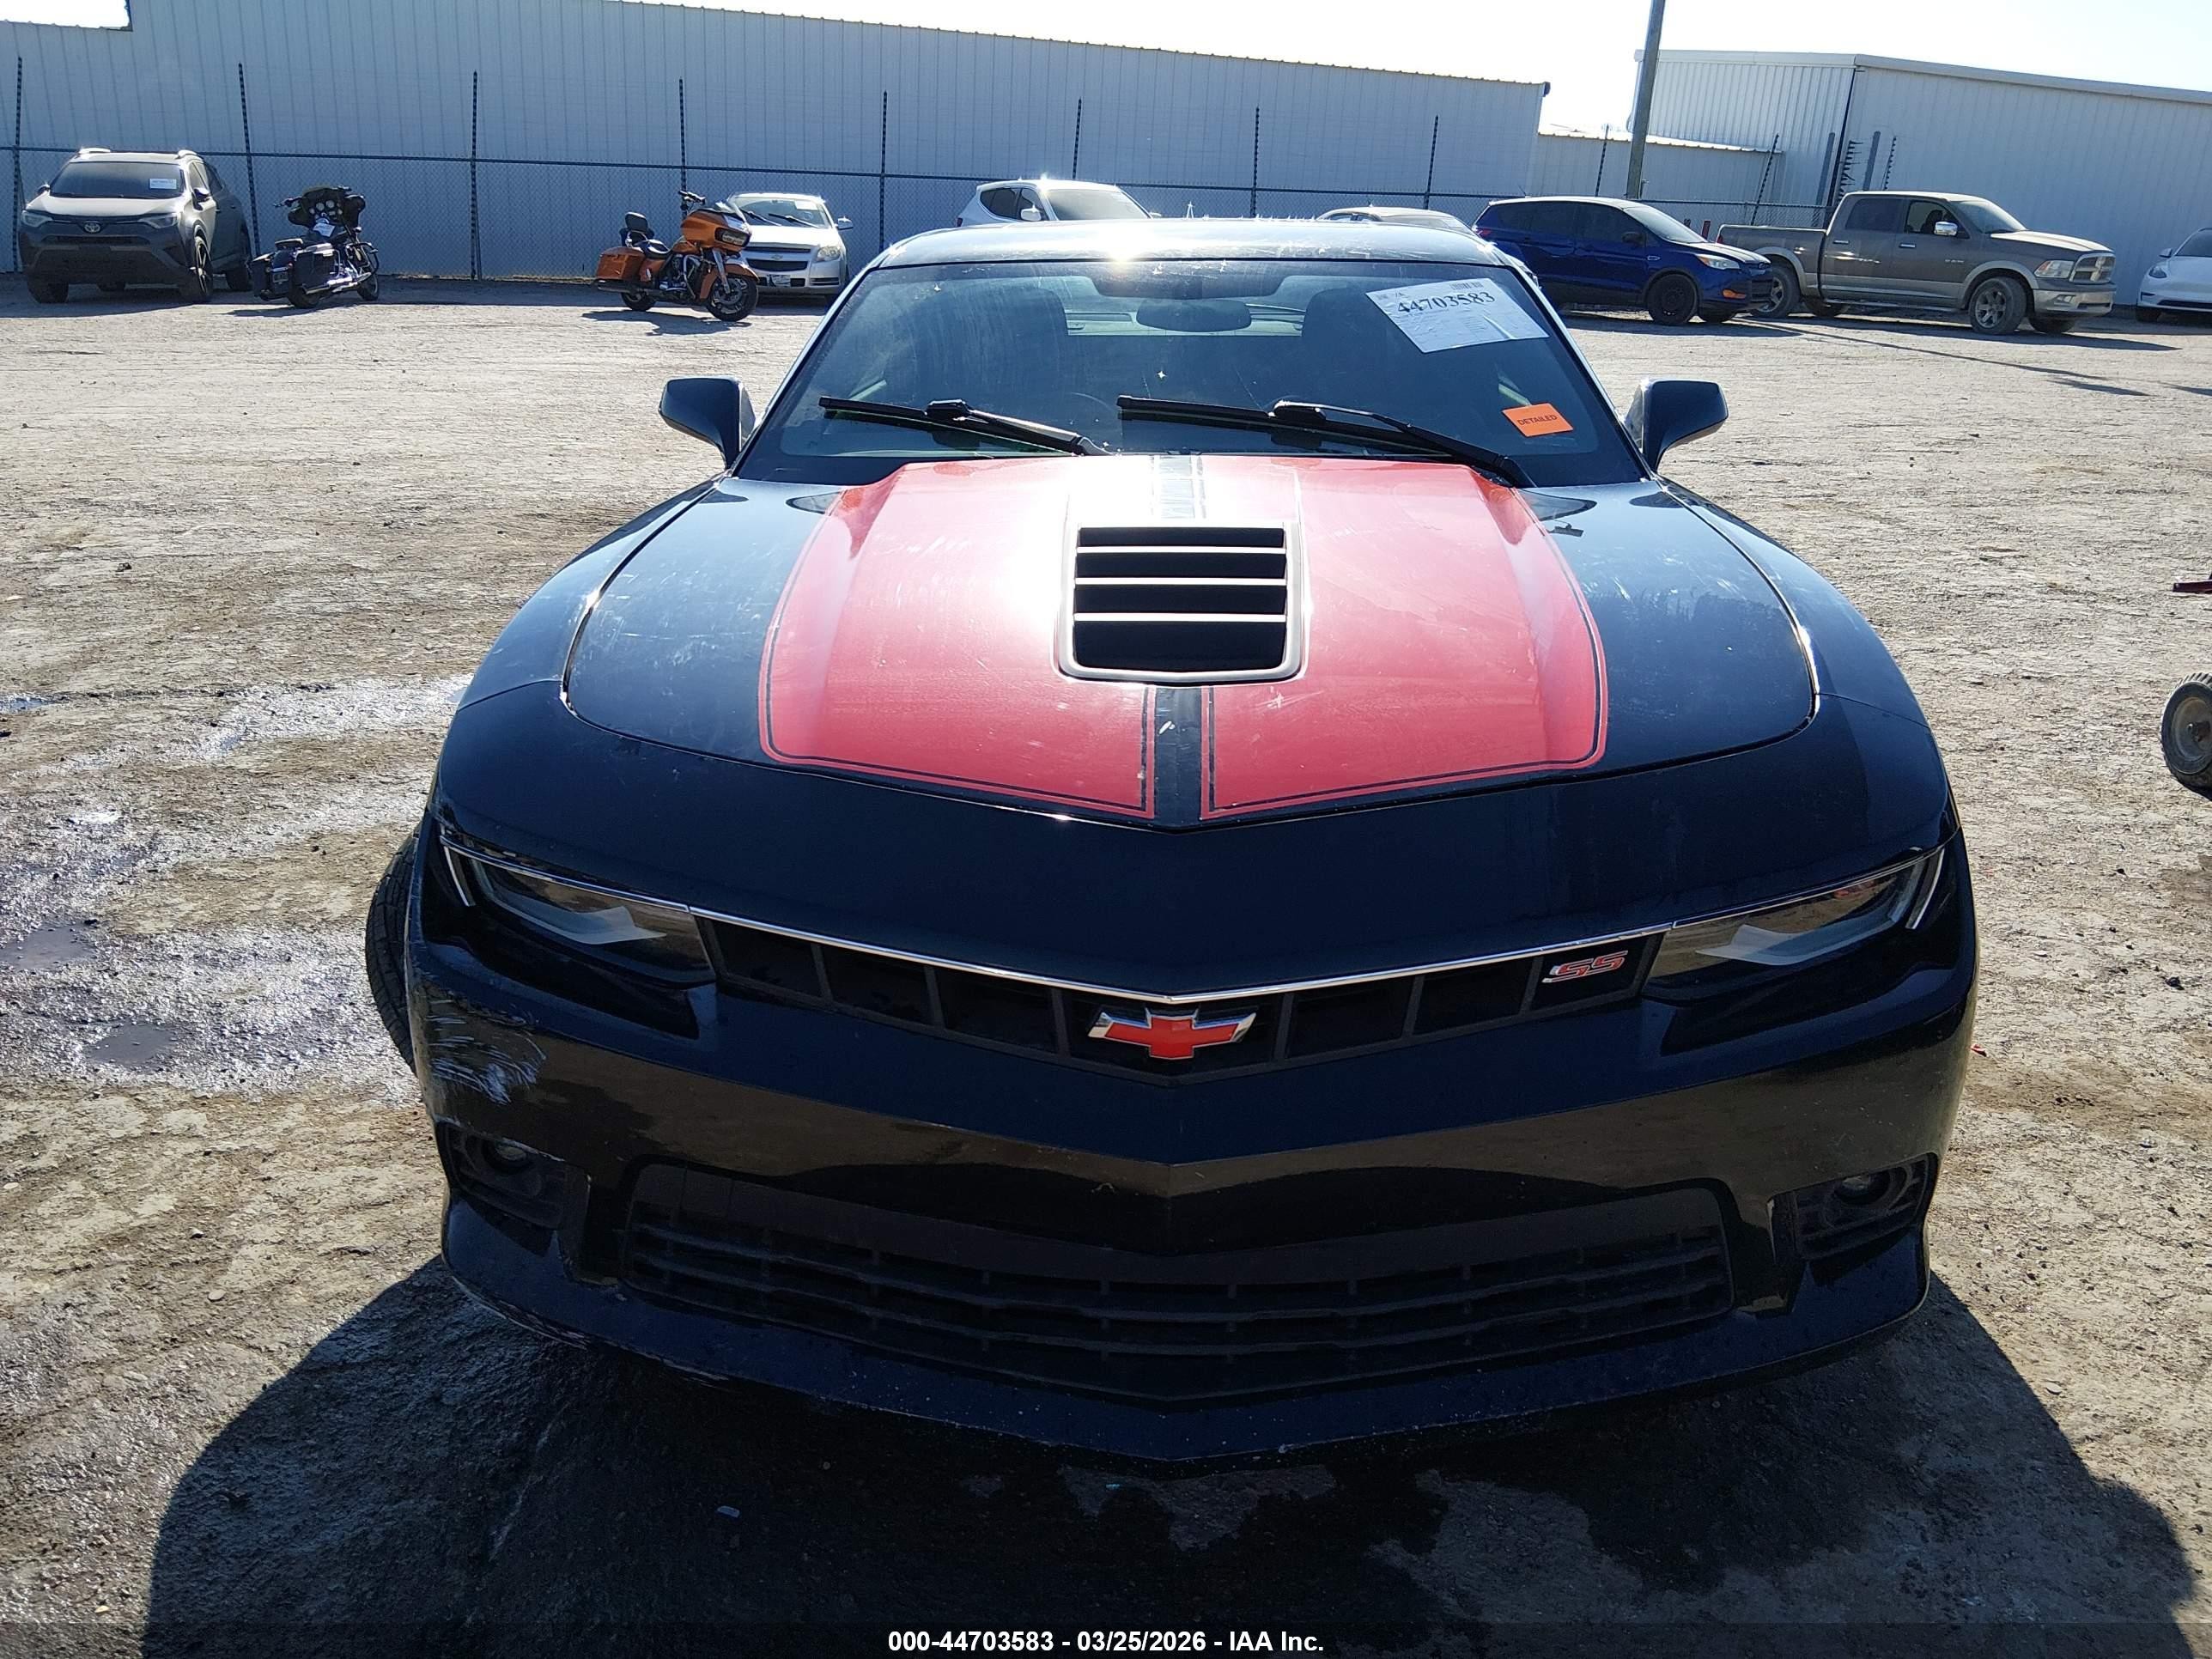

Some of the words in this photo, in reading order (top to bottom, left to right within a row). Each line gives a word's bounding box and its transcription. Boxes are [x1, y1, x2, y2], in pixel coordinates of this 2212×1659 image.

[1398, 291, 1495, 313] 44703583
[1516, 413, 1558, 426] DETAILED
[1542, 950, 1628, 983] SS
